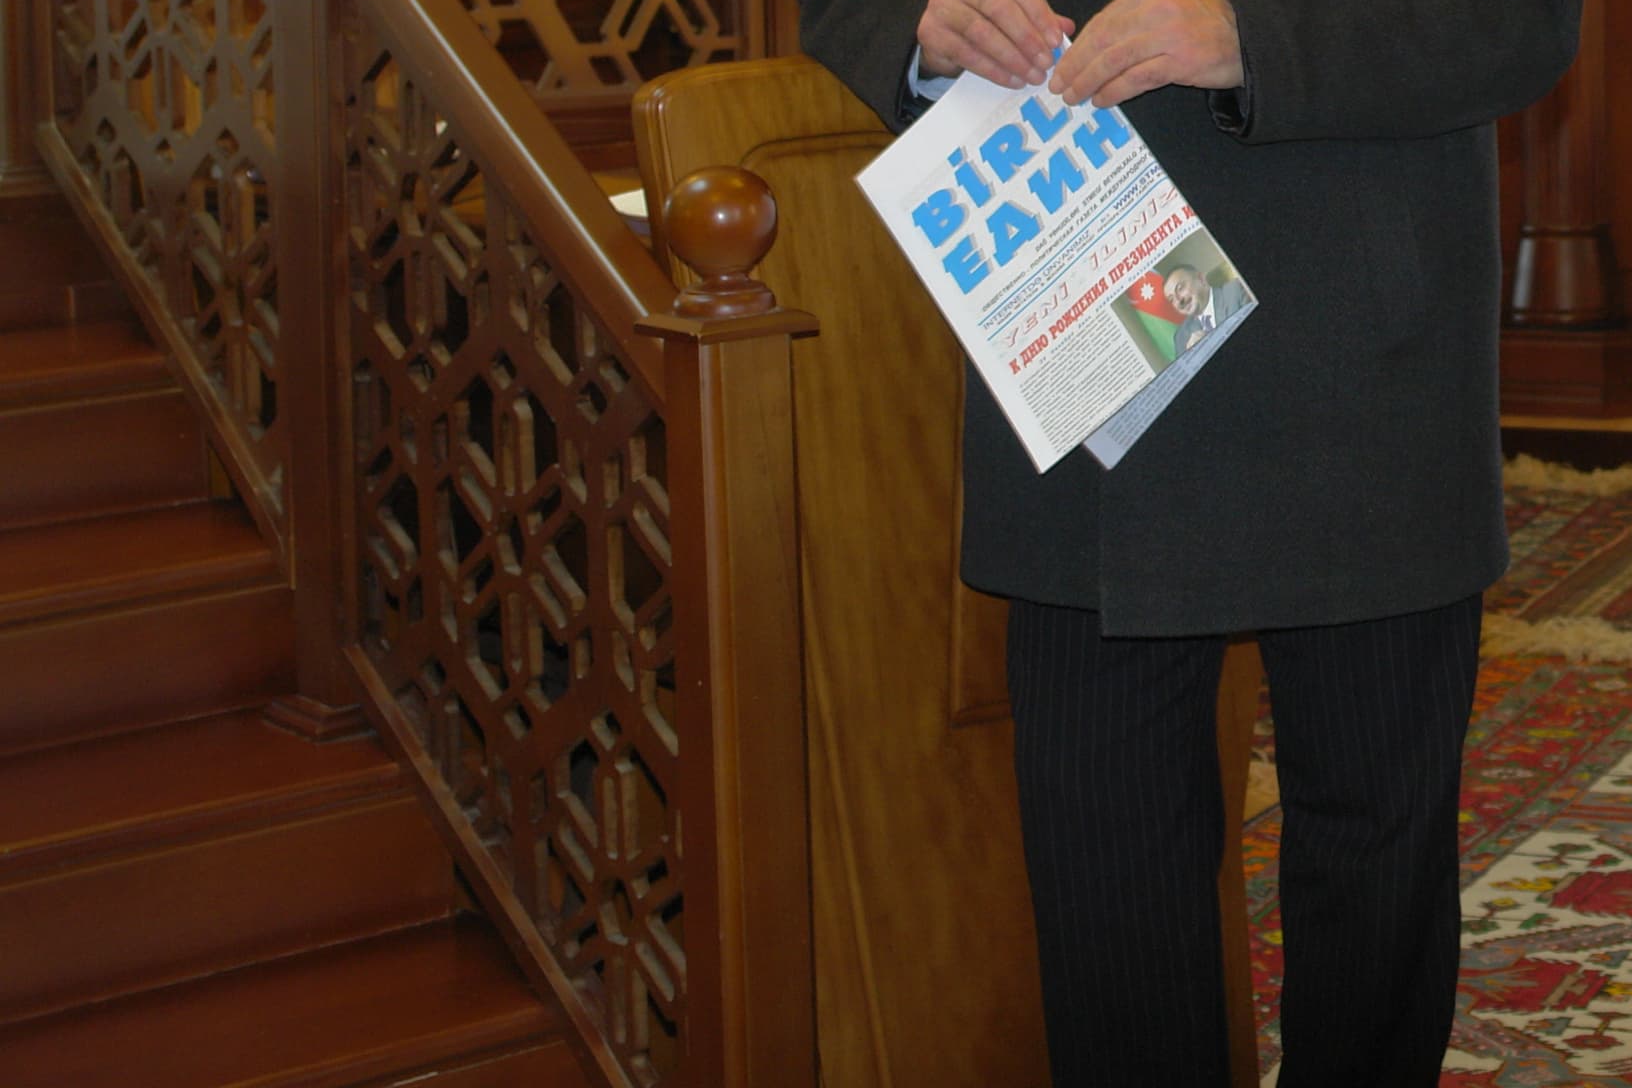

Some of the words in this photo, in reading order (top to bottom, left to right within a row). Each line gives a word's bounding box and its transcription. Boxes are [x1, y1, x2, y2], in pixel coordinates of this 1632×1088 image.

[911, 92, 1090, 249] BİRL
[1008, 357, 1021, 375] К
[1017, 331, 1050, 367] ДНЮ
[1048, 277, 1108, 340] РОЖДЕНИЯ
[1107, 213, 1183, 284] ПРЕЗИДЕНТА
